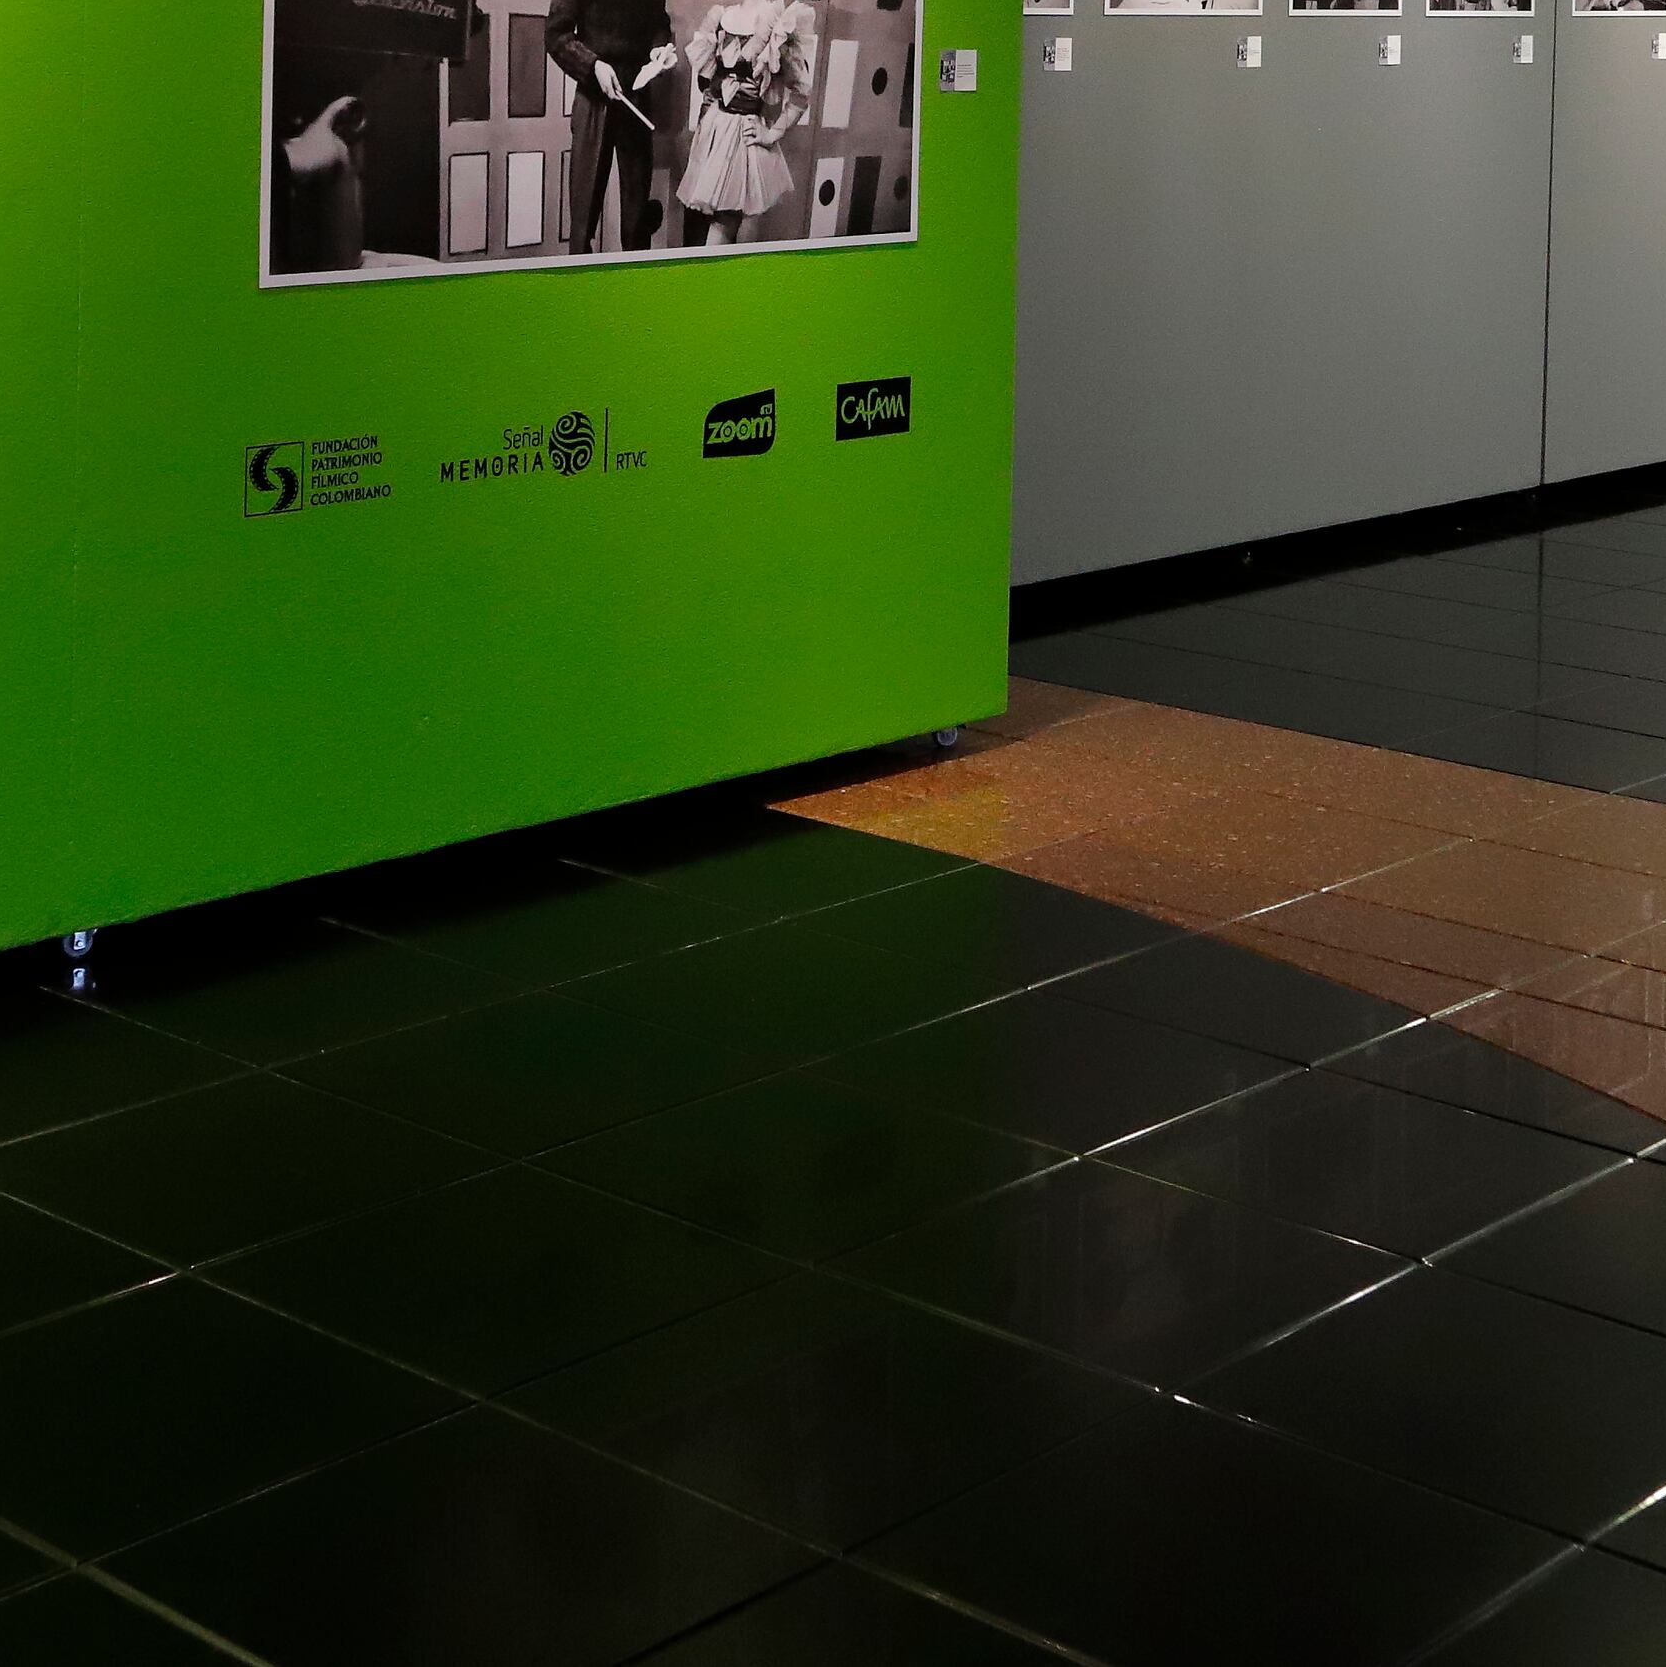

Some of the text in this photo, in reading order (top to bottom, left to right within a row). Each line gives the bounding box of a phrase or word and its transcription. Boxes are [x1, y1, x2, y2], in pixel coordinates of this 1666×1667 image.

[312, 434, 378, 455] FUNDACIÓN
[503, 425, 544, 450] Señal
[312, 452, 382, 472] PATRIMONIO
[440, 451, 544, 482] MEMORIA
[616, 450, 647, 470] RTVC
[311, 471, 359, 489] FÍLMICO
[310, 484, 392, 506] COLOMBIANO
